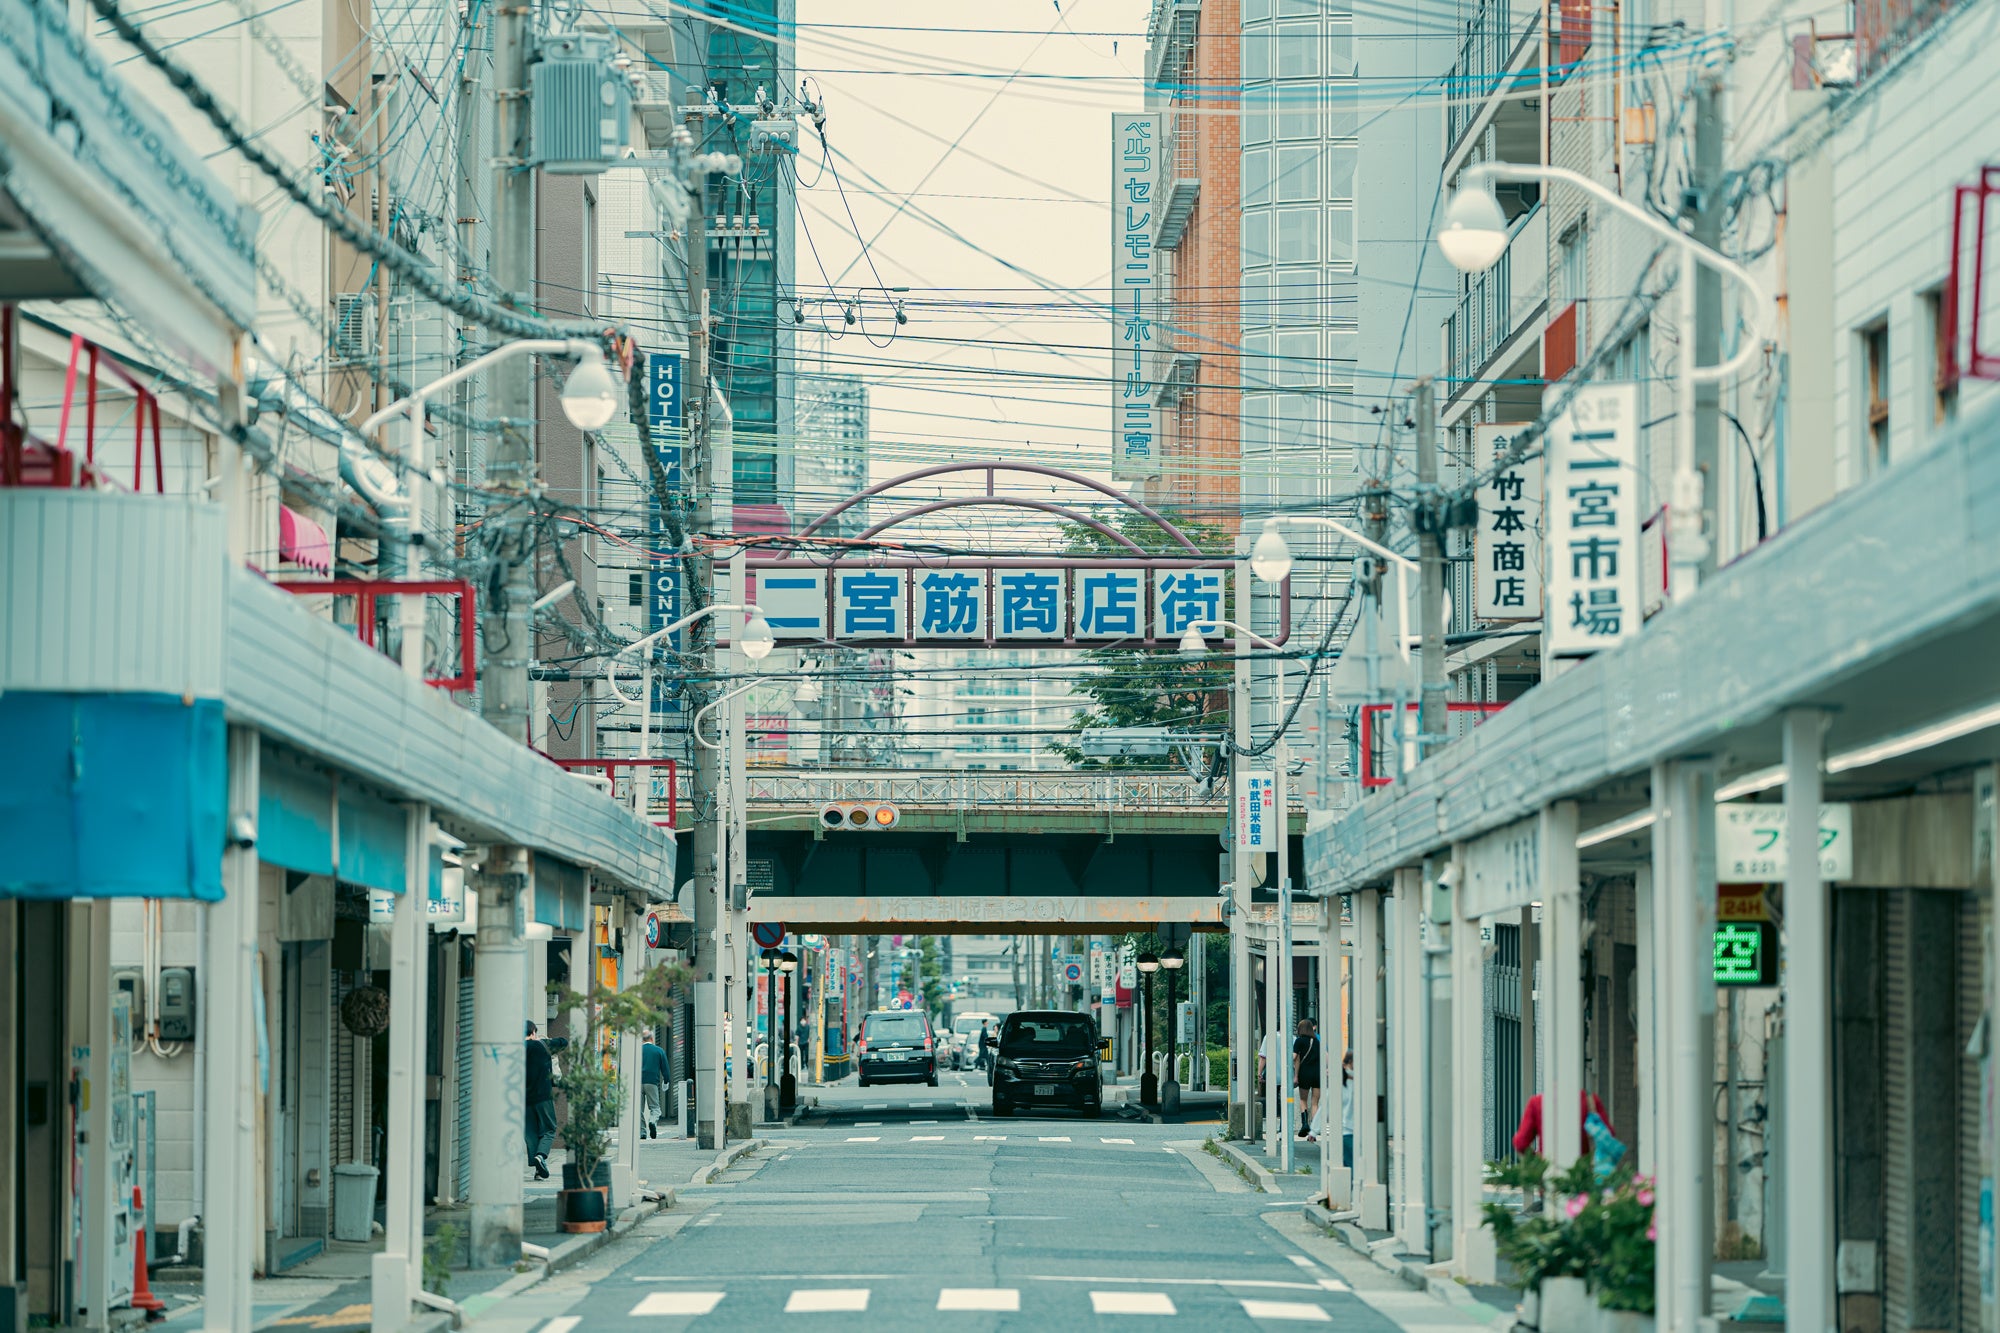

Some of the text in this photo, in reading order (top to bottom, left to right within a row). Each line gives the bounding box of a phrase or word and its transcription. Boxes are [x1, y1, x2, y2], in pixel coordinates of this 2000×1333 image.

[657, 364, 674, 454] HOTEL
[1492, 471, 1525, 607] 竹本商店
[1566, 430, 1622, 635] 二宮市場
[764, 572, 1220, 634] 二宮筋商店街
[1724, 901, 1762, 915] 24H
[1714, 925, 1759, 981] 空
